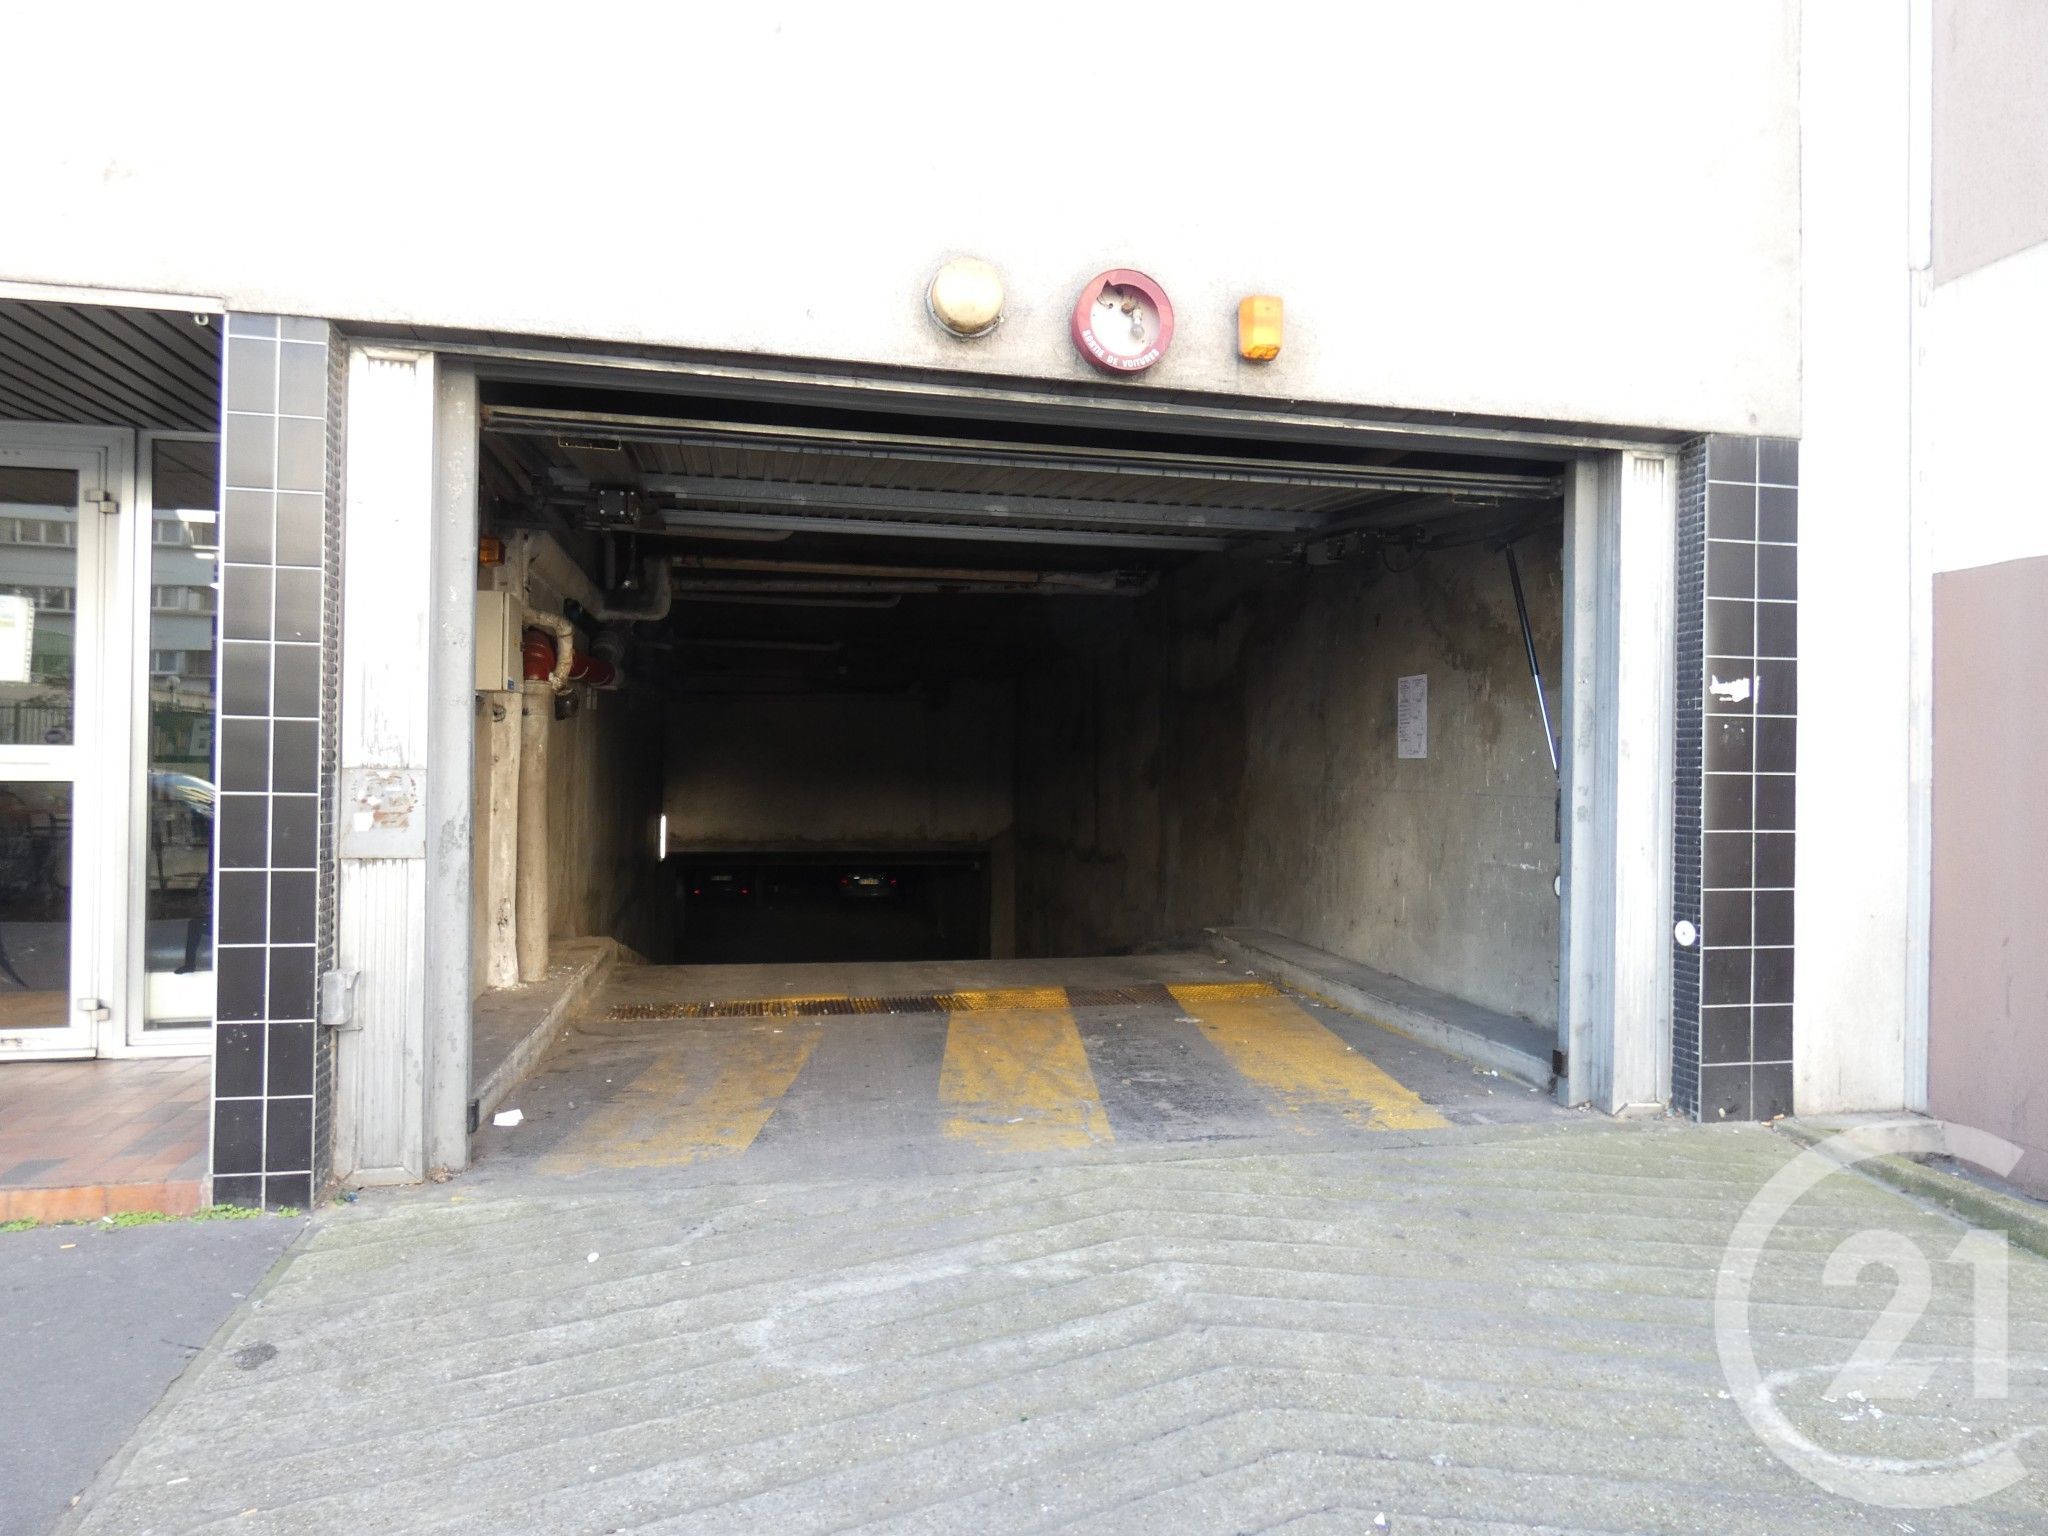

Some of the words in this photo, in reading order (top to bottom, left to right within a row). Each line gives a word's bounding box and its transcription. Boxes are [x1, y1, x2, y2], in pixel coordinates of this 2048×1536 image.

[1081, 329, 1105, 358] SORTIE
[1106, 354, 1119, 366] DE
[1121, 348, 1160, 368] VOITURES
